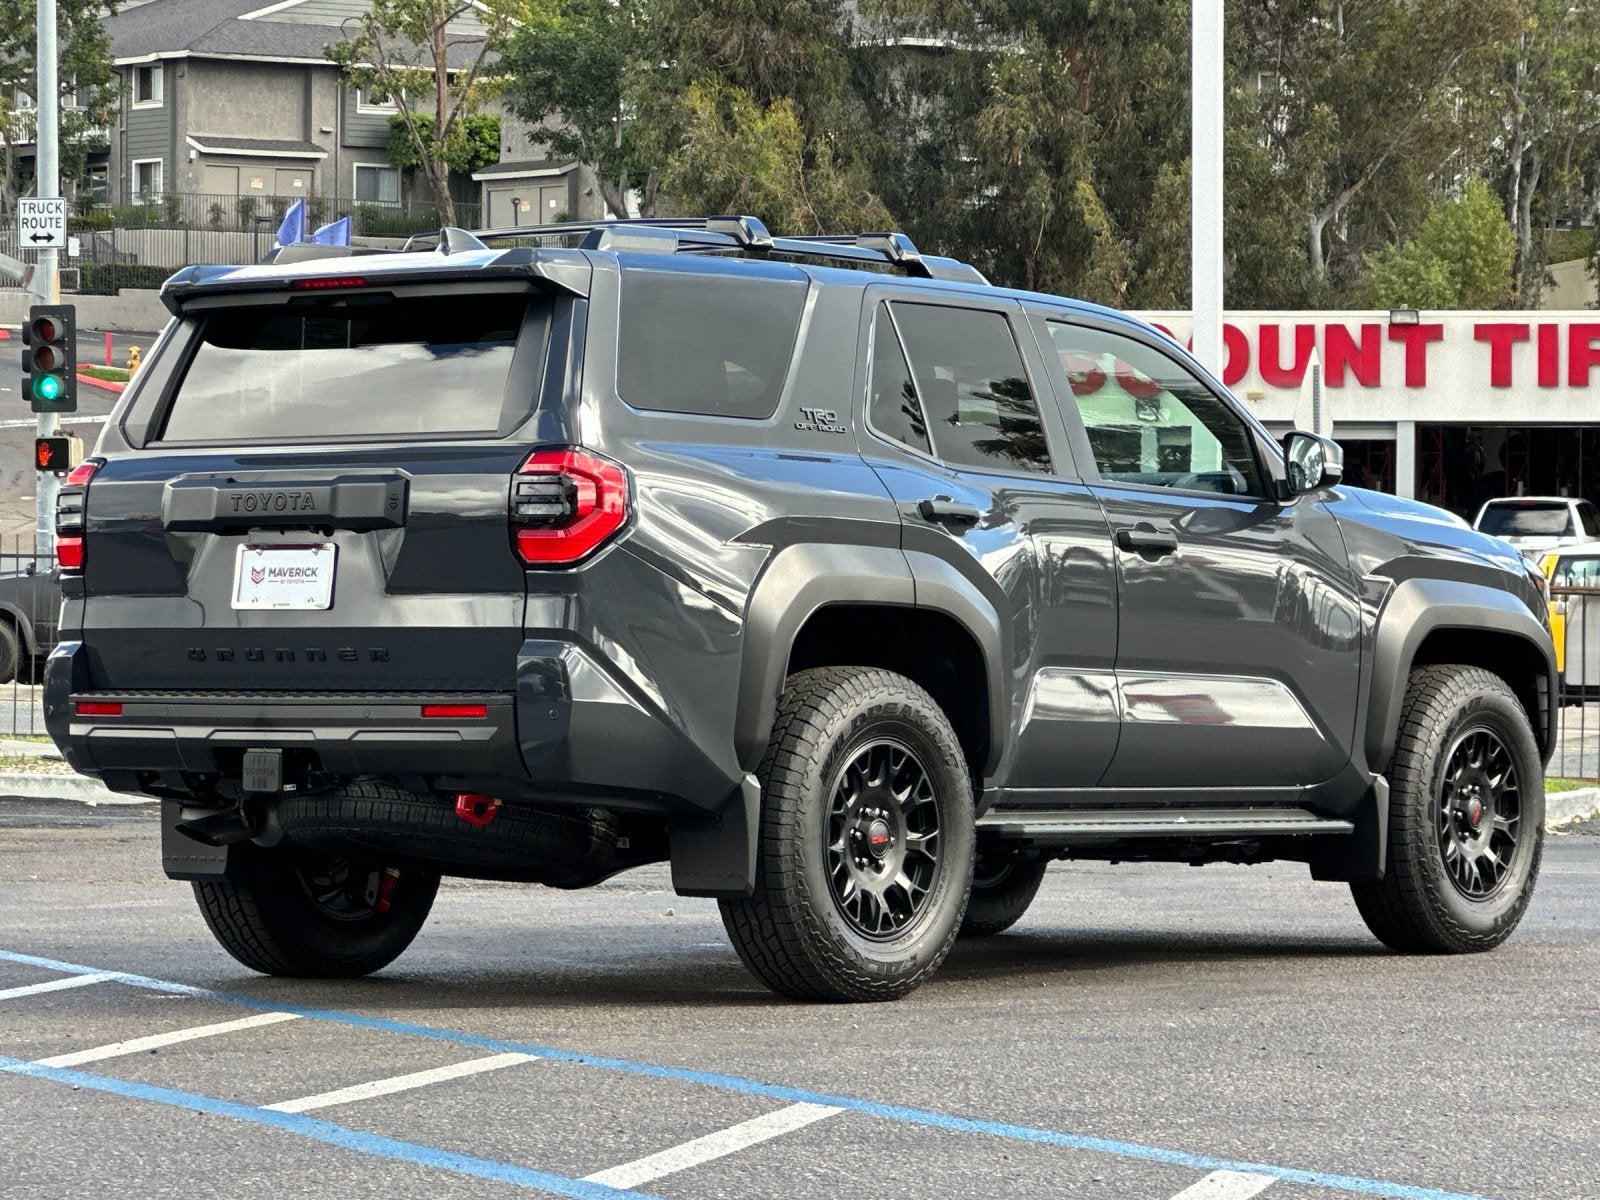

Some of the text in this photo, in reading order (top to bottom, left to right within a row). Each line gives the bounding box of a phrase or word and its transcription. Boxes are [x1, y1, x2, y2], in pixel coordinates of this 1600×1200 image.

[22, 202, 63, 214] TRUCK
[21, 217, 62, 229] ROUTE
[800, 407, 838, 425] TRD
[817, 424, 848, 434] ROAD
[231, 492, 316, 513] TOYOTA
[268, 566, 319, 578] MAVERICK
[187, 647, 390, 663] 4RUNNER
